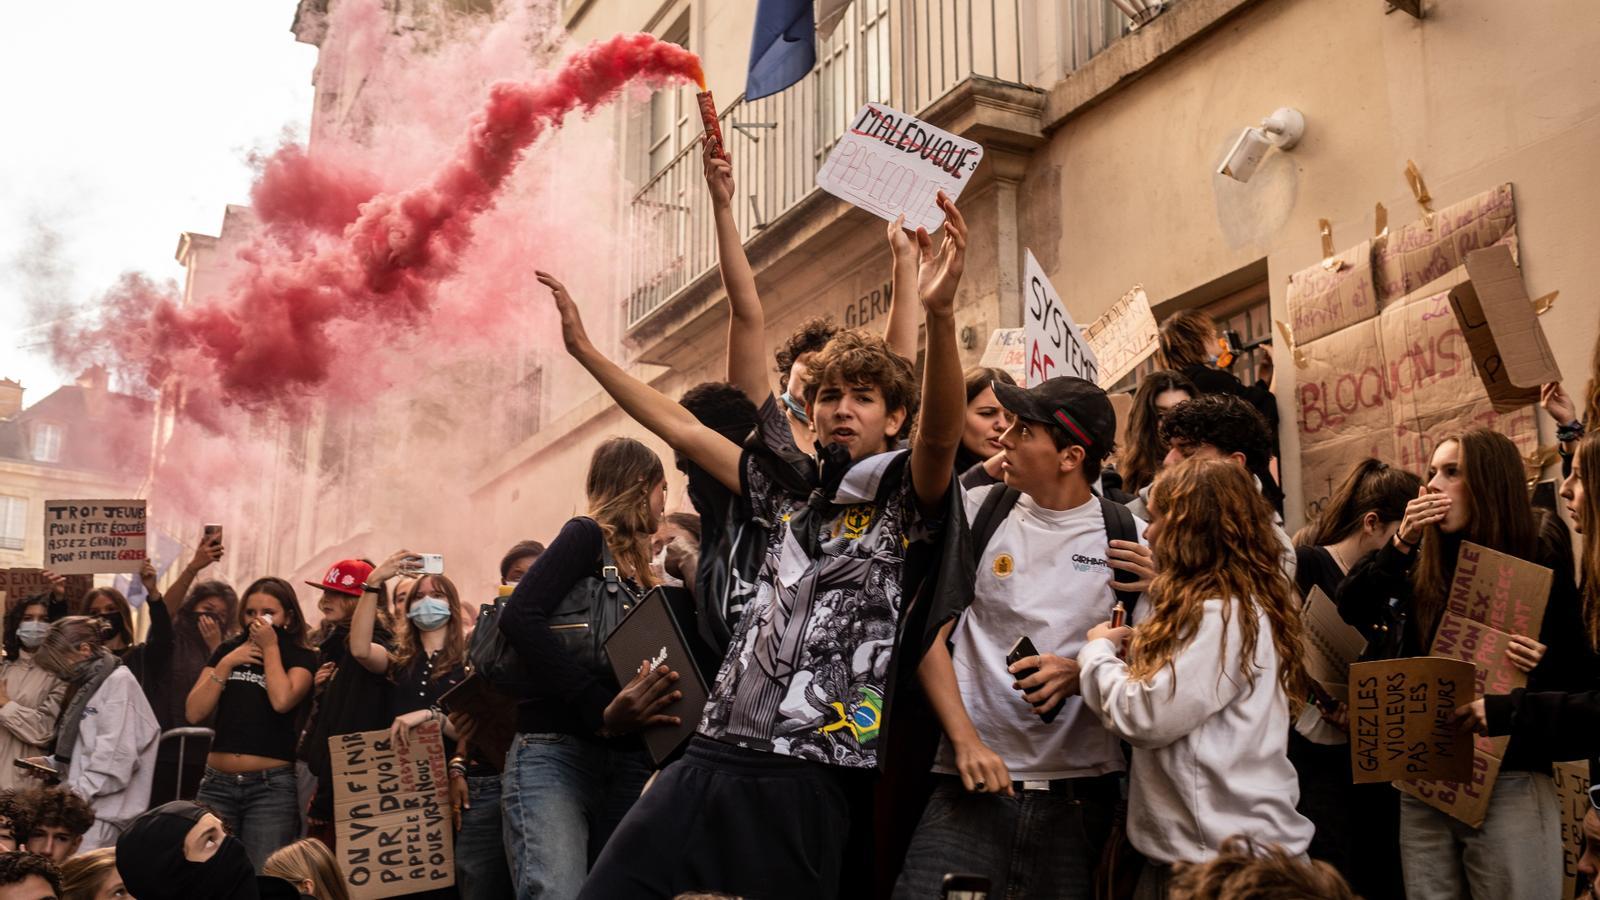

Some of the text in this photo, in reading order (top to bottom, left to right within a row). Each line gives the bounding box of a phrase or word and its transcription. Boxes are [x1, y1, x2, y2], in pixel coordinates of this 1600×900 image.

[827, 141, 872, 190] PAS
[1301, 328, 1464, 433] BLOQUONS
[48, 506, 99, 520] TROP
[50, 523, 77, 536] POUR
[80, 520, 108, 535] ÊTRE
[48, 537, 128, 550] ASSEZ GRANDS
[50, 552, 75, 565] POUR
[78, 552, 87, 560] SE
[90, 551, 117, 560] FAIRE
[1471, 591, 1490, 624] EX
[1409, 682, 1428, 714] LES
[1357, 676, 1379, 772] GAZEZ LES
[1406, 742, 1428, 773] PAS
[349, 804, 378, 841] VA
[403, 797, 425, 880] APPELER
[347, 847, 370, 886] ON
[378, 827, 403, 884] PAR
[426, 830, 448, 881] POUR
